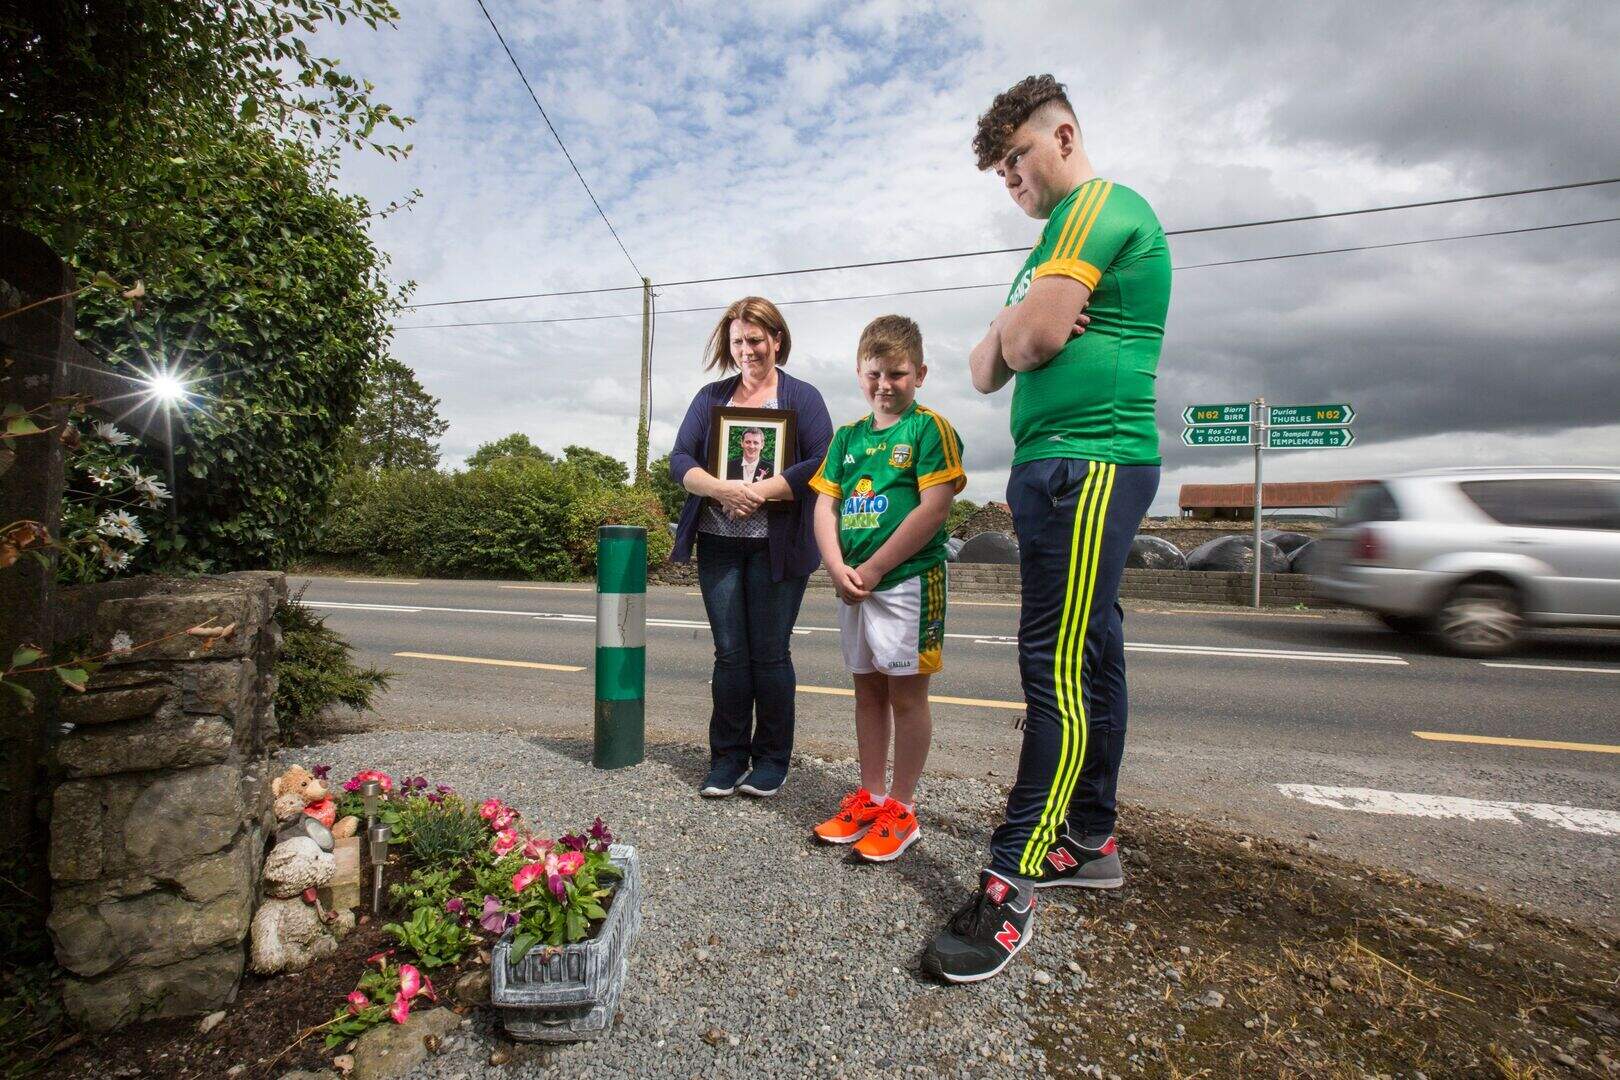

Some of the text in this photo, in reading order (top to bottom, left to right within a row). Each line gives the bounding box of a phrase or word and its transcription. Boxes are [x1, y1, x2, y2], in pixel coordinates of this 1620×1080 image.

[1197, 411, 1219, 420] N62
[1272, 408, 1297, 416] Durlas
[1317, 410, 1340, 419] N62
[1198, 435, 1204, 443] 5
[1272, 438, 1325, 446] TEMPLEMORE
[1329, 437, 1340, 445] 13
[841, 512, 881, 530] PARK
[1046, 846, 1078, 872] N
